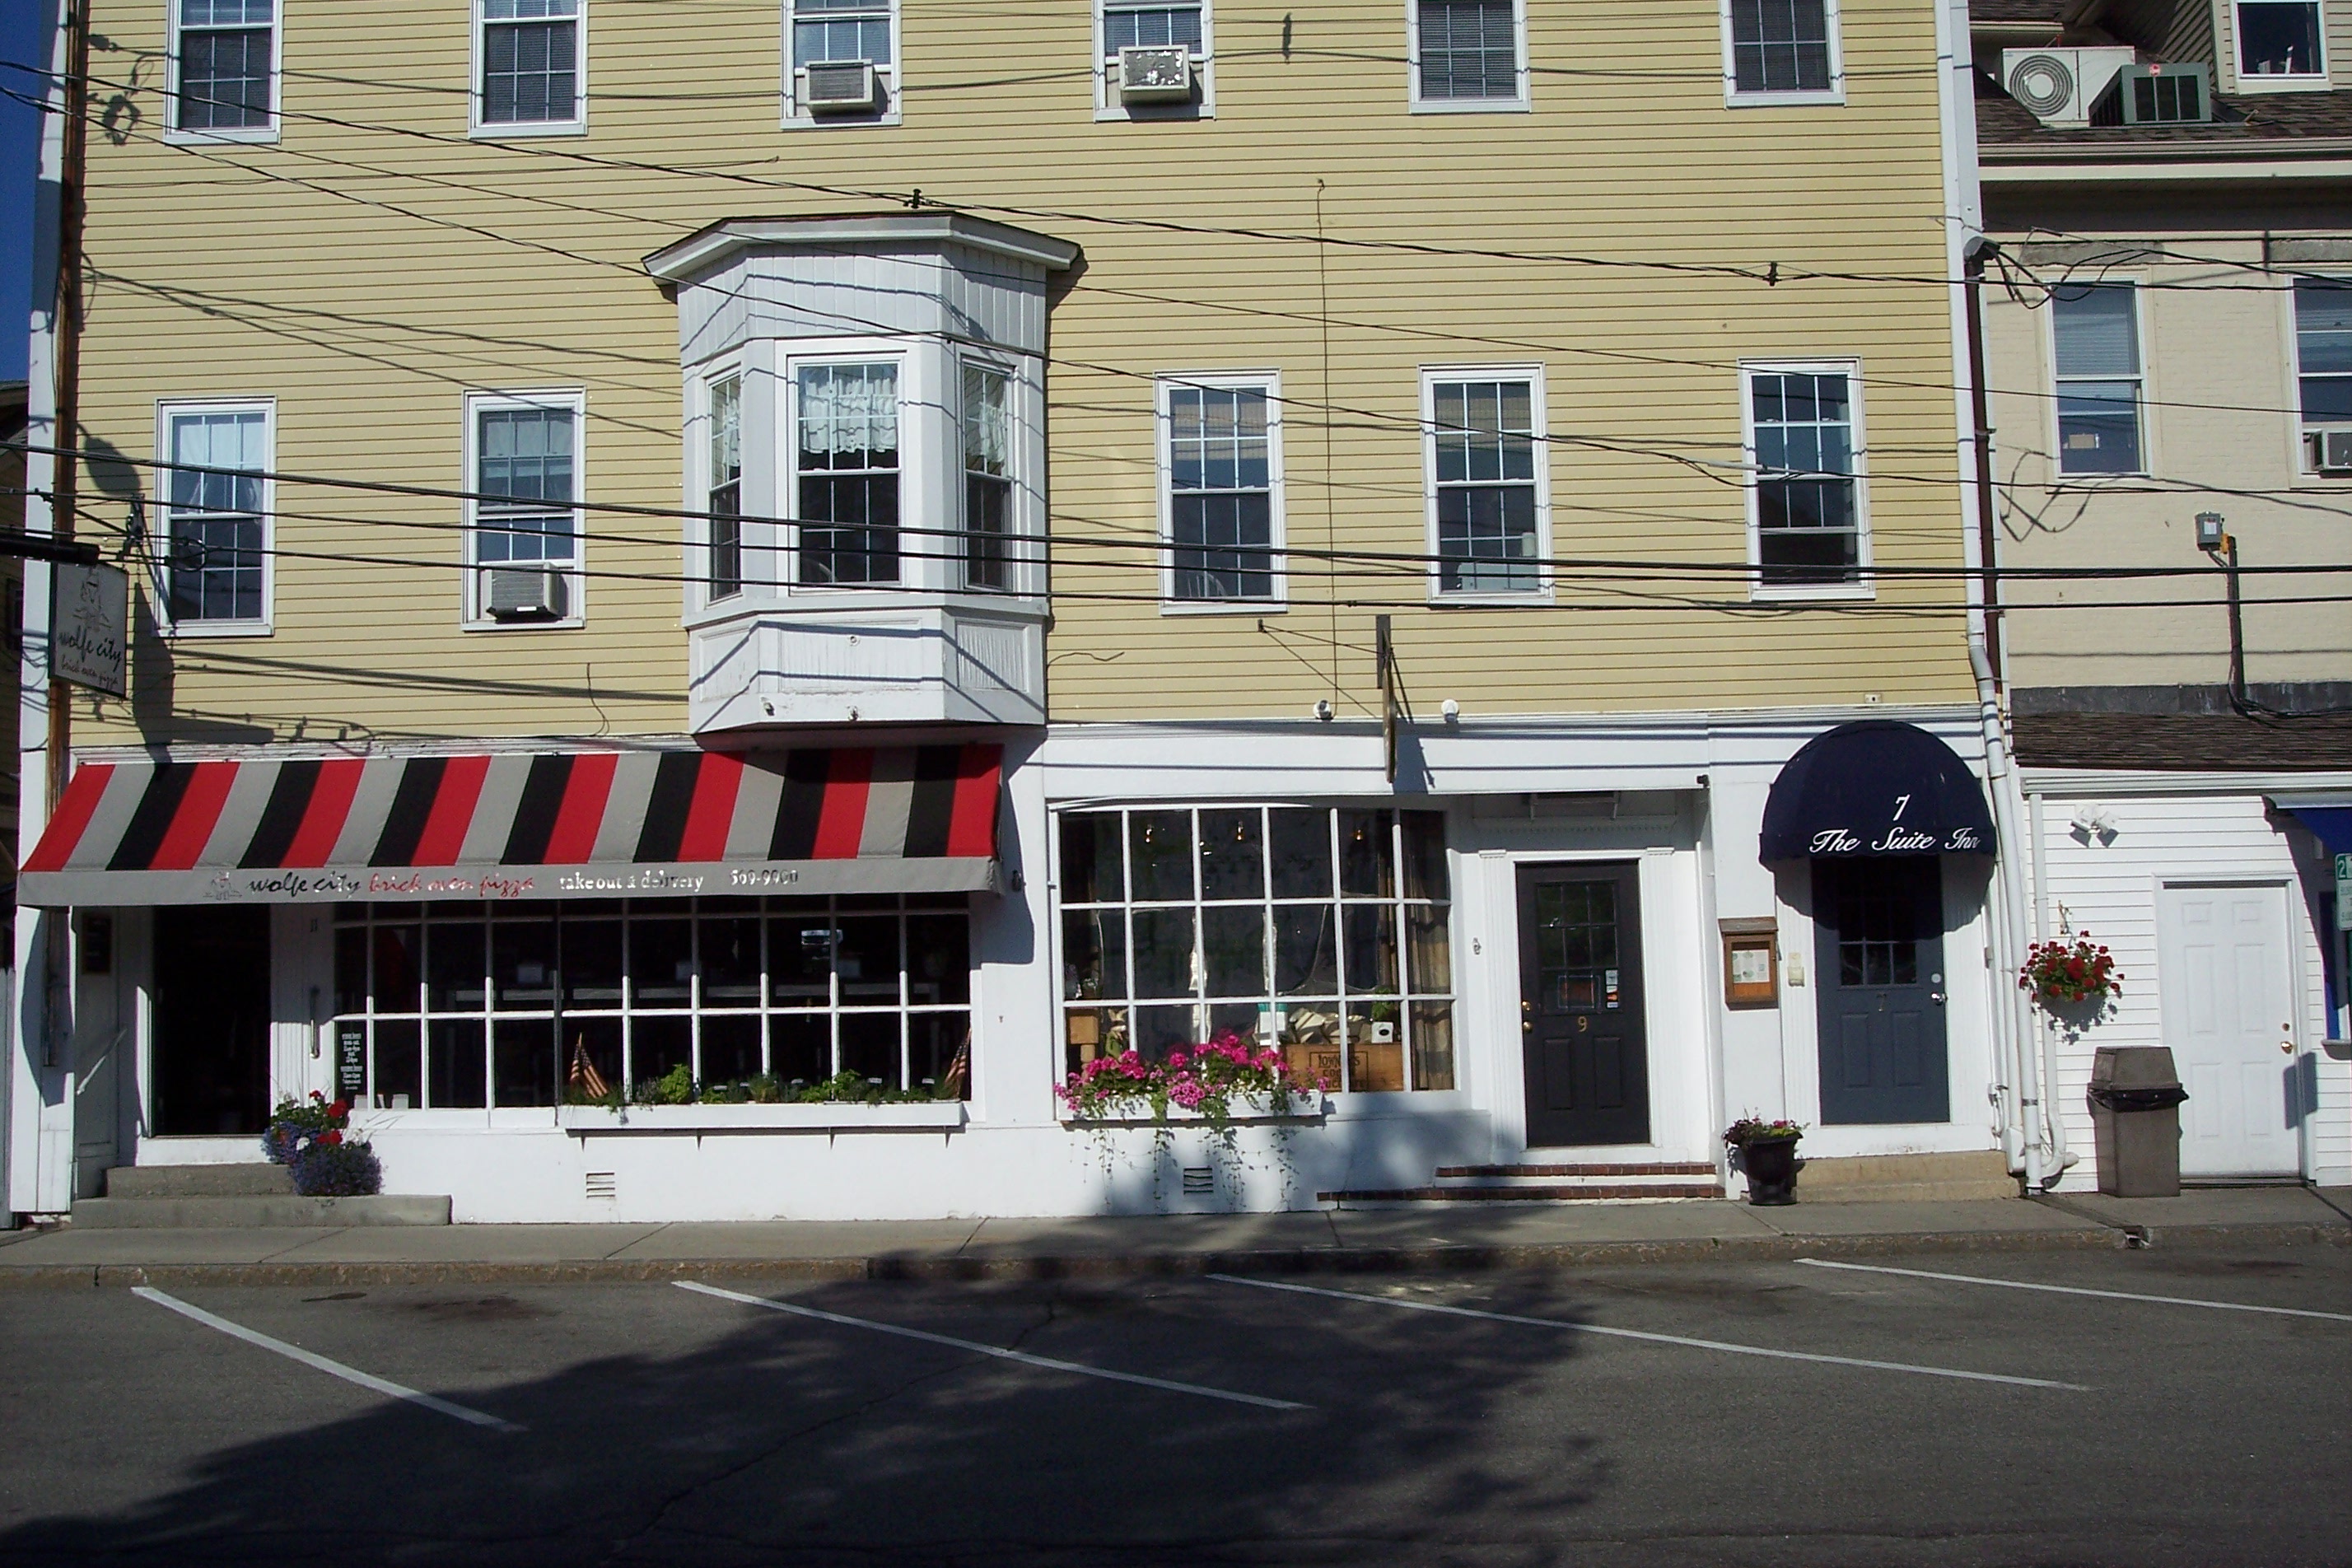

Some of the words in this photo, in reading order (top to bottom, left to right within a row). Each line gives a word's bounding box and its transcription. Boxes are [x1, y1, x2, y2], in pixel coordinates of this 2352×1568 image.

[58, 625, 94, 663] wolfe
[96, 637, 122, 673] city
[1892, 794, 1911, 822] 7
[1808, 828, 1861, 853] The
[1871, 826, 1936, 851] Suite
[1944, 827, 1981, 851] Inn
[246, 871, 309, 898] wolfe
[313, 870, 362, 899] city
[368, 872, 423, 894] brick
[427, 877, 474, 892] oven
[478, 873, 535, 898] pizza
[641, 870, 704, 893] delivery
[1577, 1015, 1588, 1033] 9
